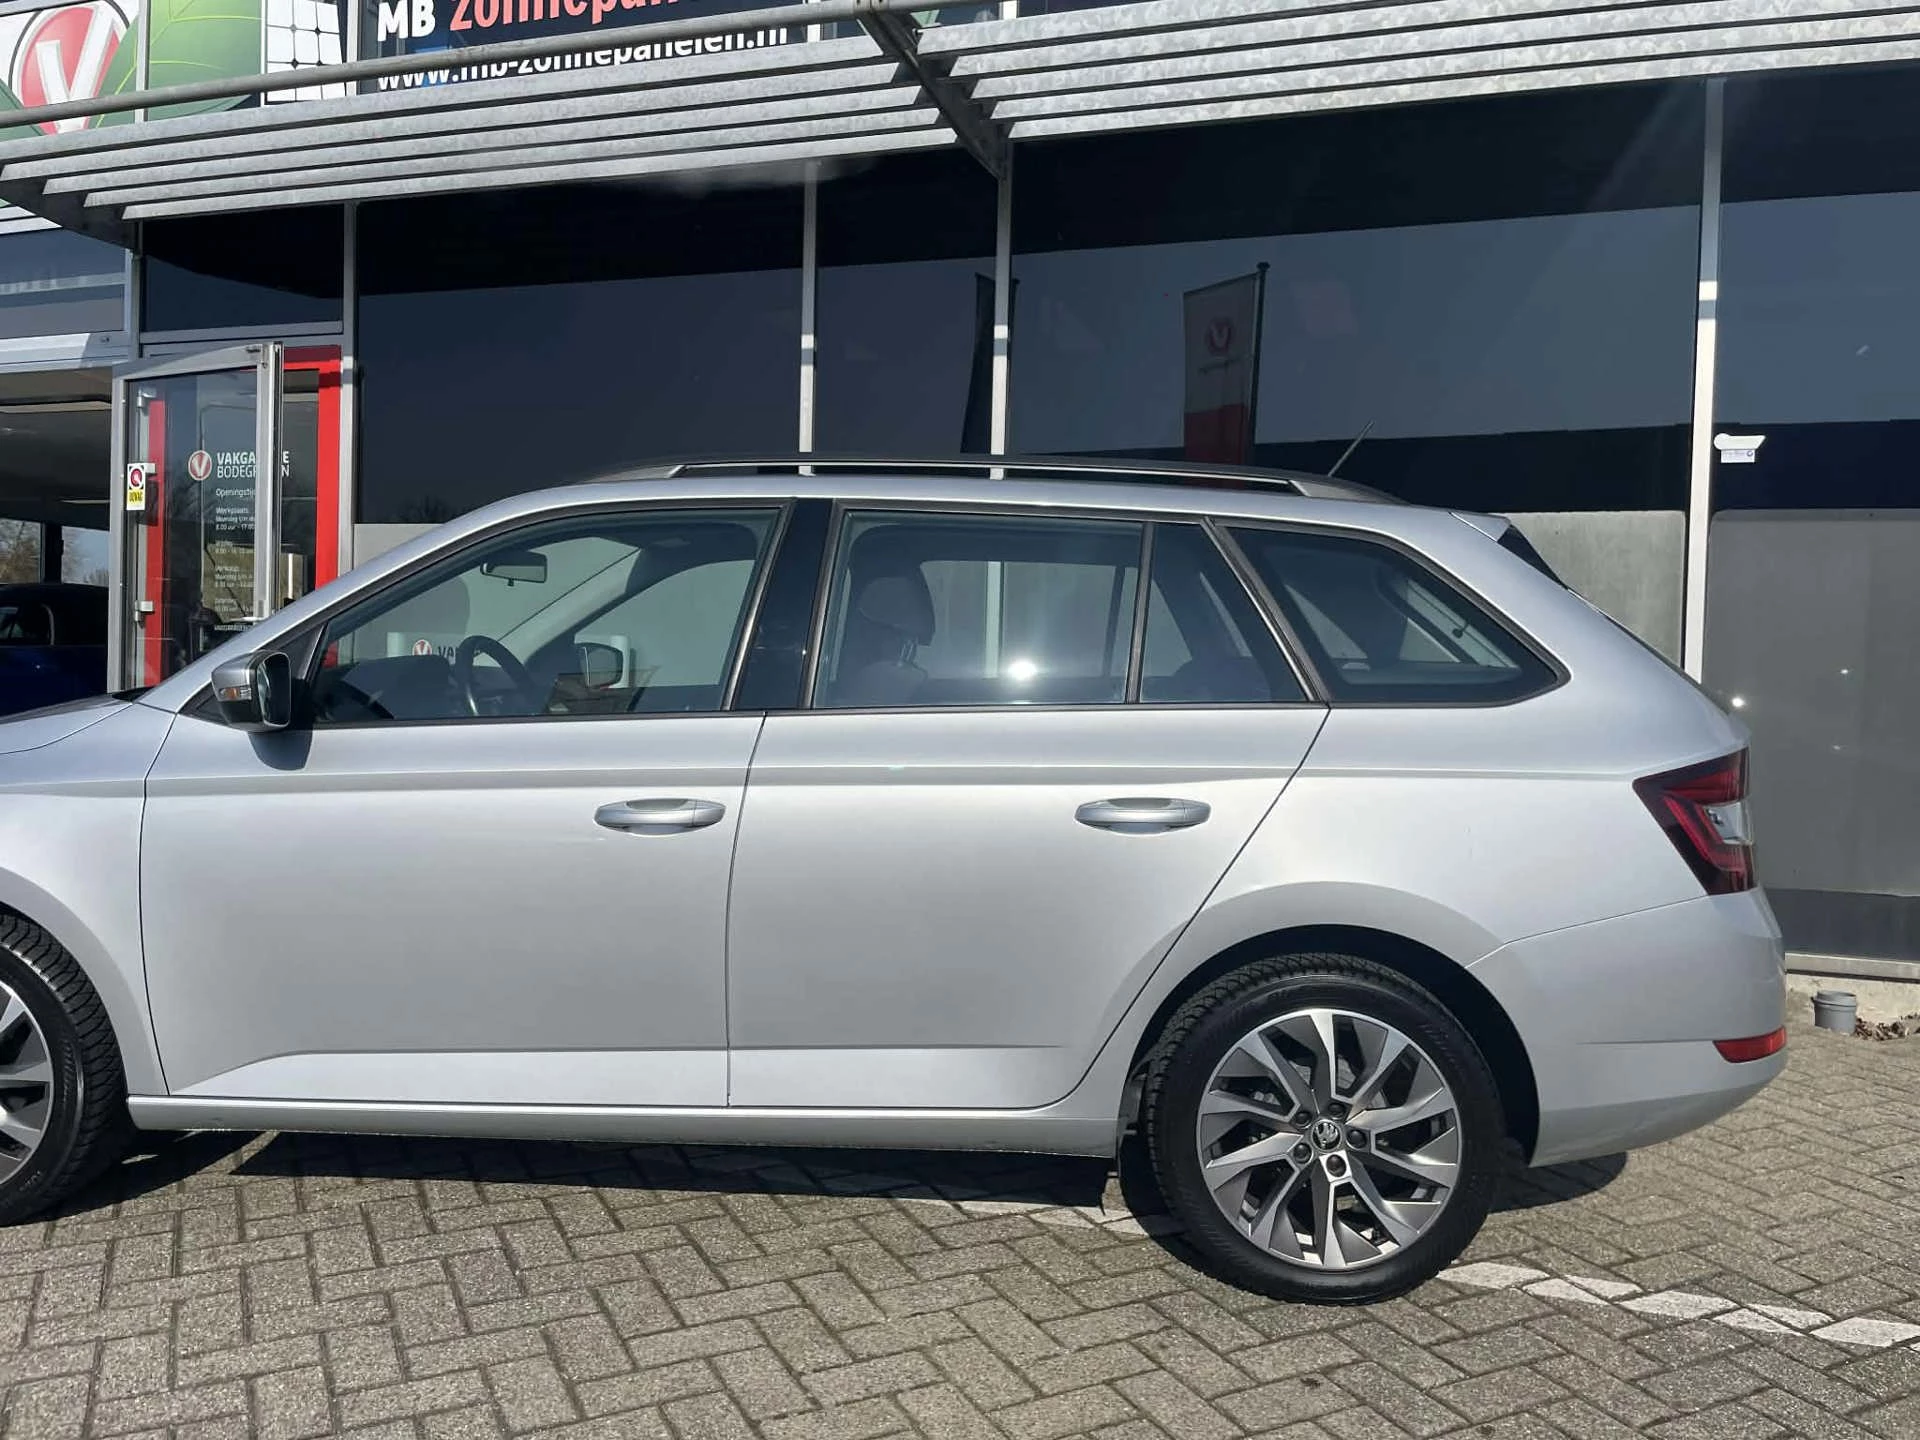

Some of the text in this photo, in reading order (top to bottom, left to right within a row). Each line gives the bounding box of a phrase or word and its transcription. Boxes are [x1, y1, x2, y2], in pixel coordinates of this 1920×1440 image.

[377, 0, 436, 42] MB
[217, 451, 290, 465] VAKGAE
[217, 465, 290, 478] BODEGN
